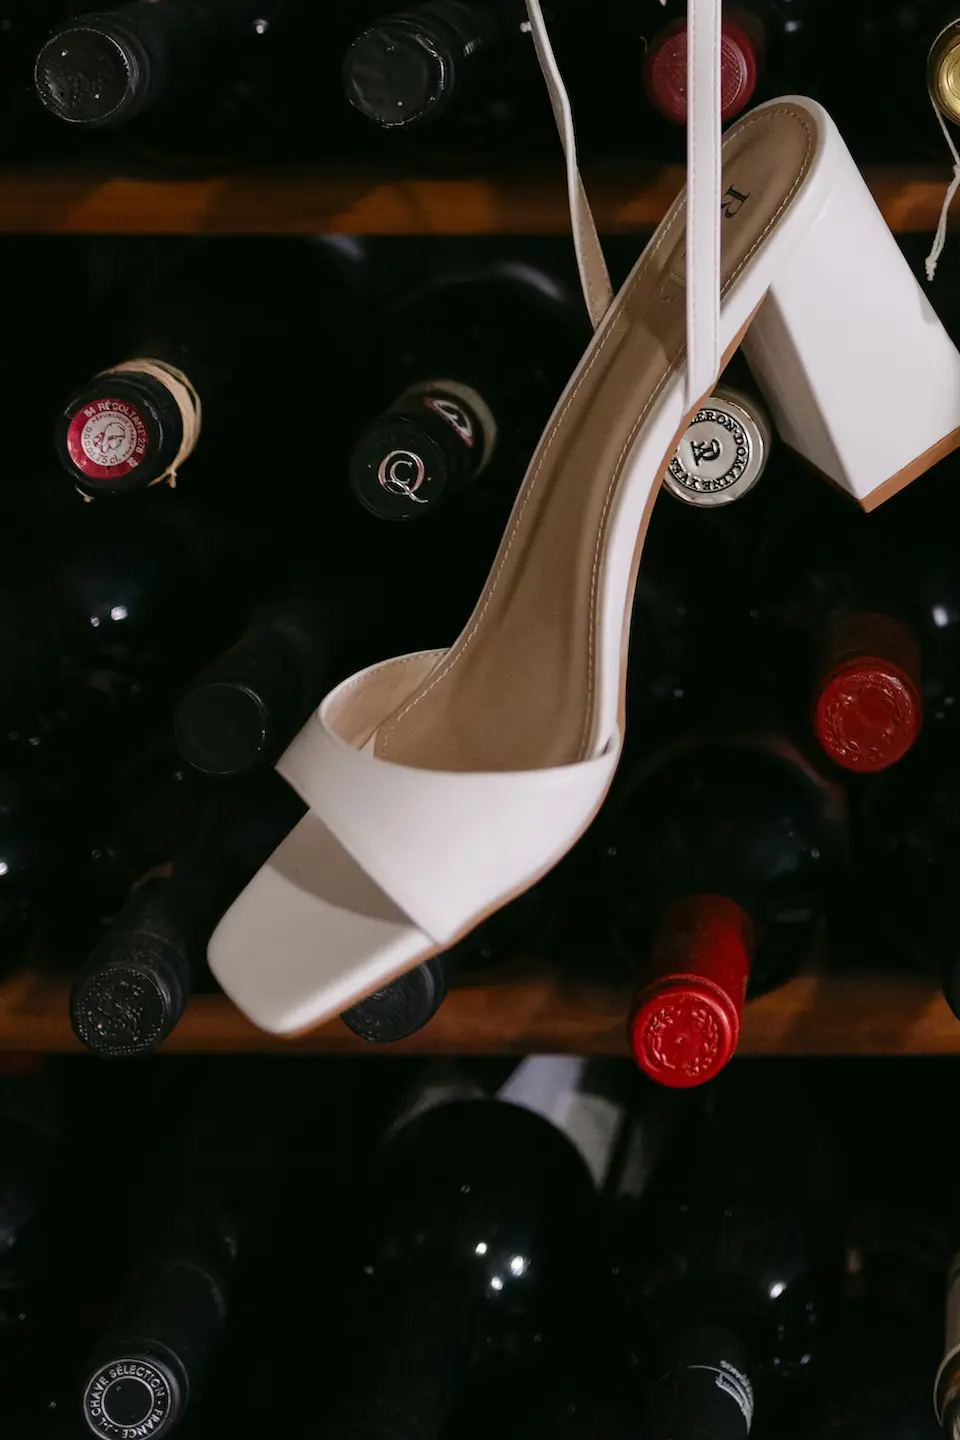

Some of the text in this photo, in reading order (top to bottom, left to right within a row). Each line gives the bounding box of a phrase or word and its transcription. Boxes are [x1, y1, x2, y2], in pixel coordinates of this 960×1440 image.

[89, 1376, 109, 1417] CHAVE
[109, 1363, 166, 1397] SÉLECTION
[121, 1407, 164, 1440] FRANCE
